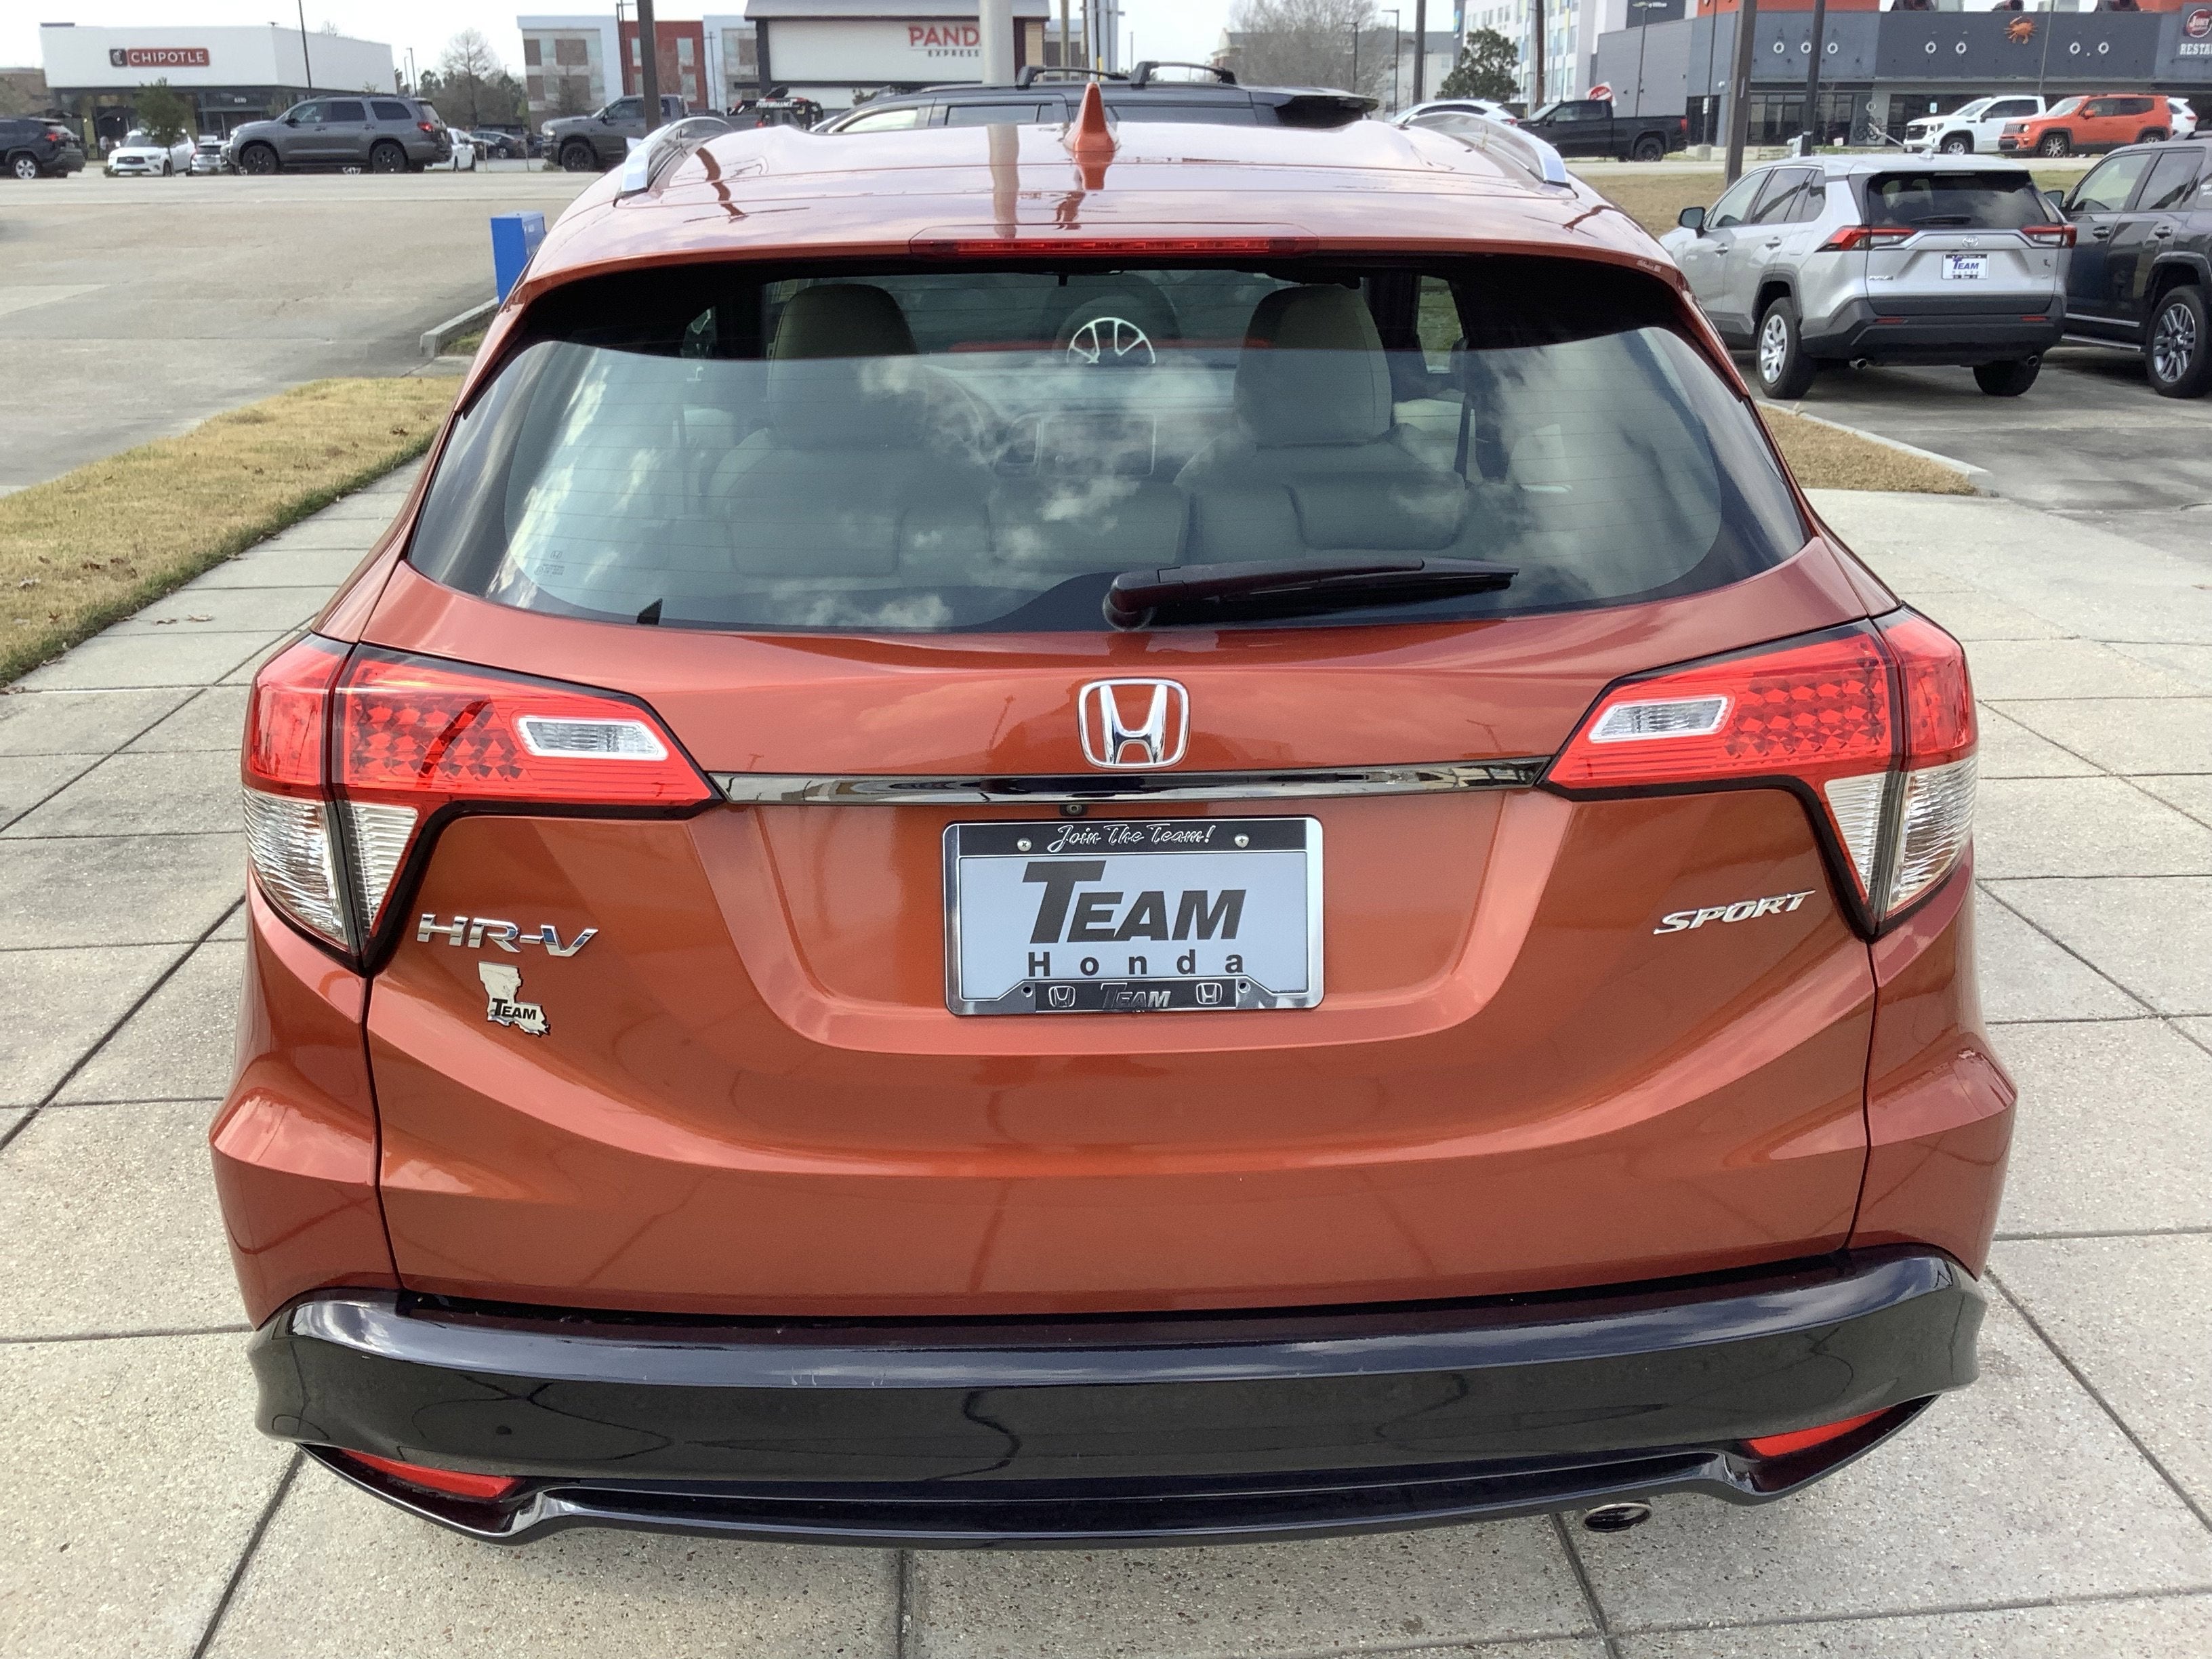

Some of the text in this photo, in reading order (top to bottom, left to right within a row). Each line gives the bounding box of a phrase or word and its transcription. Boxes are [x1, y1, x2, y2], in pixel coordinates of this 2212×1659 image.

[908, 26, 981, 47] PAND
[131, 52, 205, 63] CHIPOTLE
[927, 49, 980, 58] EXPRESS
[1047, 823, 1215, 853] Join The Team!
[1021, 859, 1247, 944] TEAM
[1652, 890, 1816, 935] SPORT
[416, 913, 599, 958] HR-V
[1027, 949, 1244, 977] Honda
[491, 998, 537, 1021] TEAM
[1100, 983, 1172, 1009] TEAM
